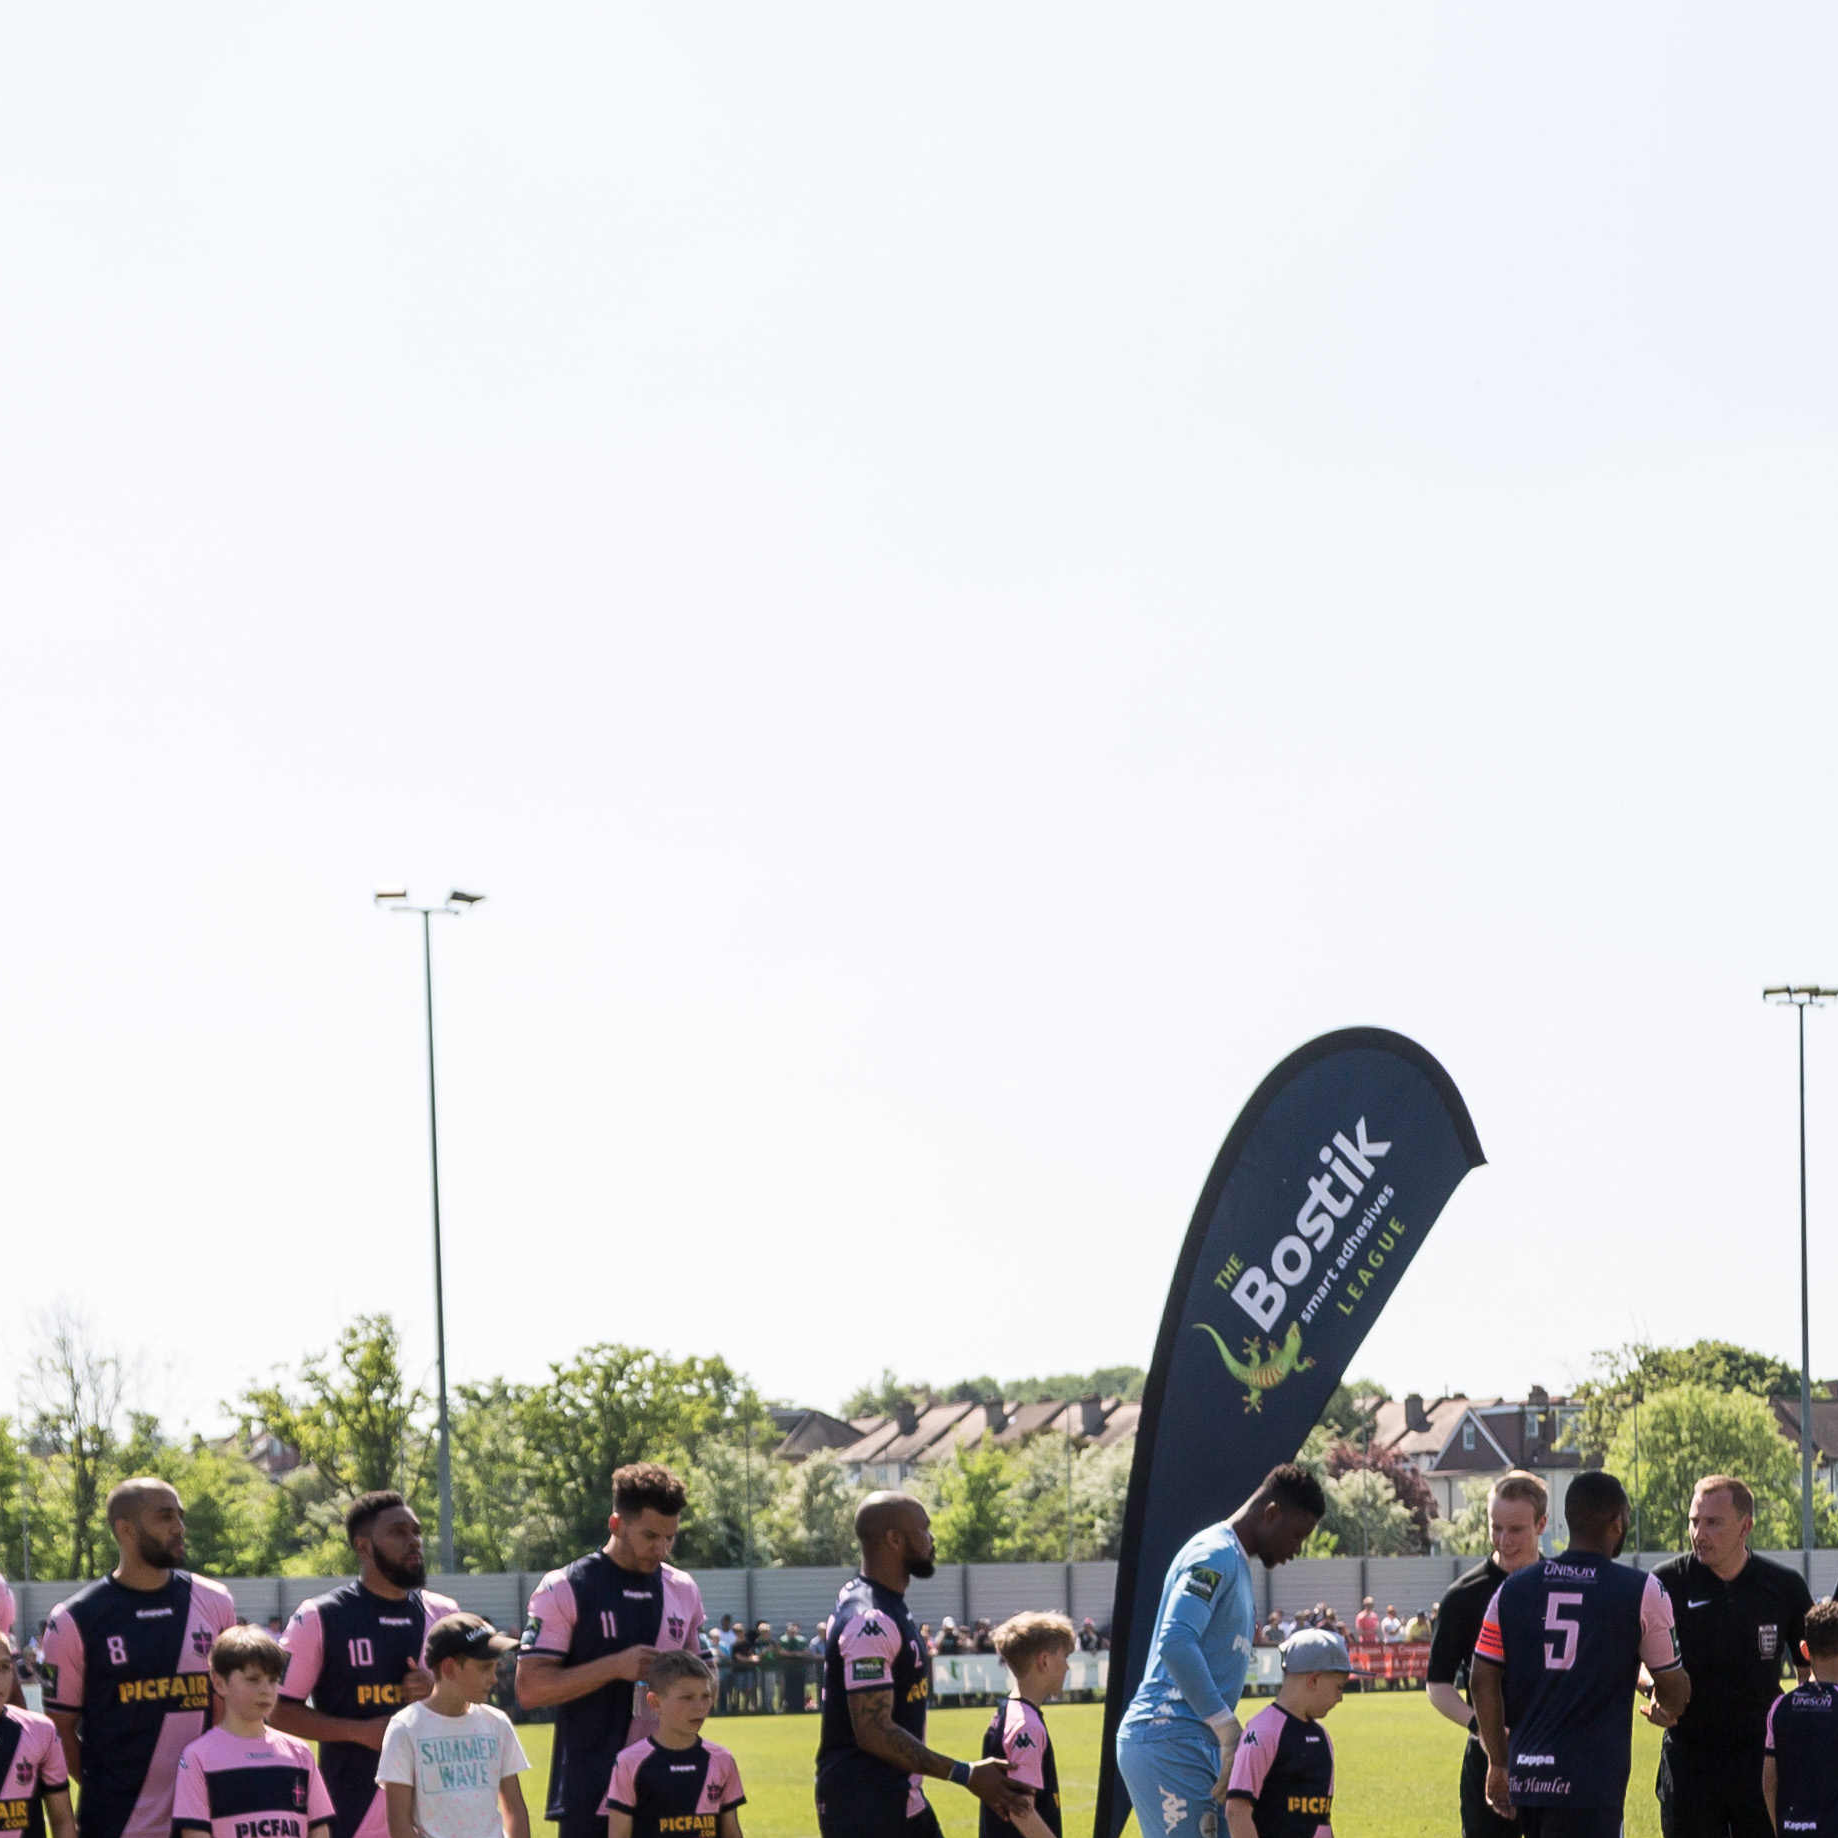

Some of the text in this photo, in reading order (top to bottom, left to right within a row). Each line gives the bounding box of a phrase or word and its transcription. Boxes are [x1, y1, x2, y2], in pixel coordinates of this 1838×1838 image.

[1230, 1115, 1392, 1333] Bostik
[1301, 1184, 1395, 1324] smart adhesives
[1337, 1216, 1406, 1316] LEAGUE
[1214, 1253, 1245, 1290] THE
[1544, 1561, 1597, 1578] UNISON
[600, 1610, 618, 1638] 11
[1545, 1592, 1583, 1670] 5
[107, 1636, 128, 1665] 8
[348, 1638, 374, 1667] 10
[118, 1675, 209, 1703] PICFAIR
[357, 1684, 402, 1705] PICF
[421, 1737, 498, 1766] SUMMER
[1516, 1754, 1555, 1767] Kappa
[439, 1763, 488, 1788] WAVE
[1524, 1776, 1571, 1795] Hamlet
[1288, 1796, 1330, 1814] PICF
[659, 1816, 716, 1833] PICFAIR
[1784, 1820, 1817, 1831] Kappa
